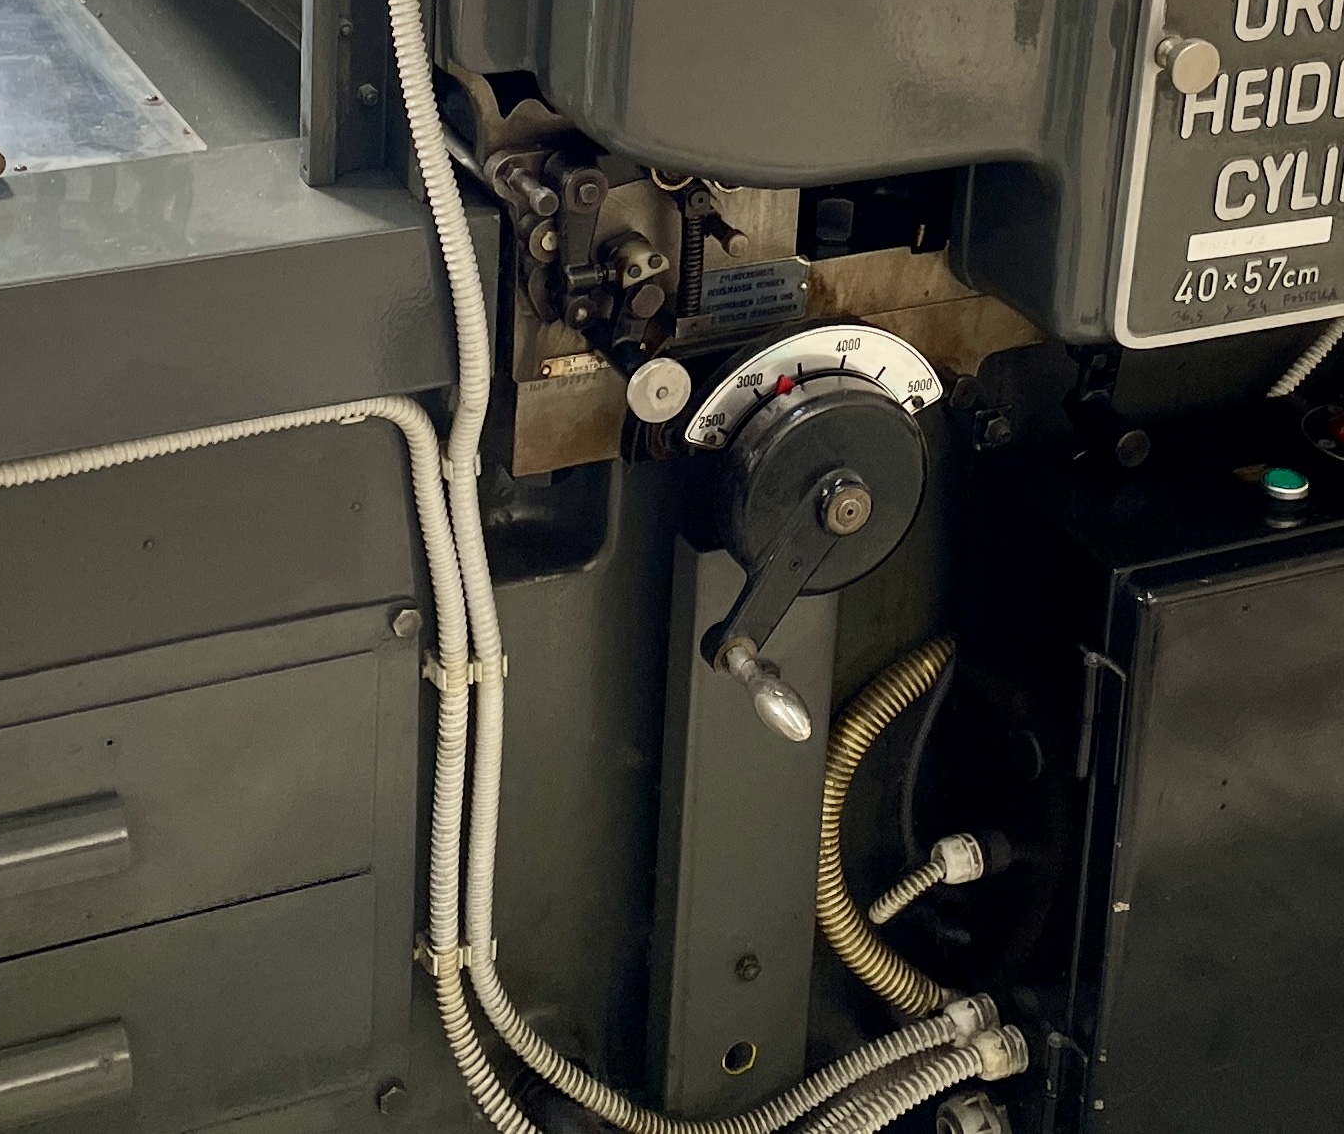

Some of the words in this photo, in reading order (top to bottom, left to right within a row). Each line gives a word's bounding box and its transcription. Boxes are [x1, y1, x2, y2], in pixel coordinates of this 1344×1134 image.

[835, 337, 861, 353] 4000
[736, 373, 764, 389] 3000
[907, 379, 933, 393] 5000
[698, 412, 725, 429] 2500
